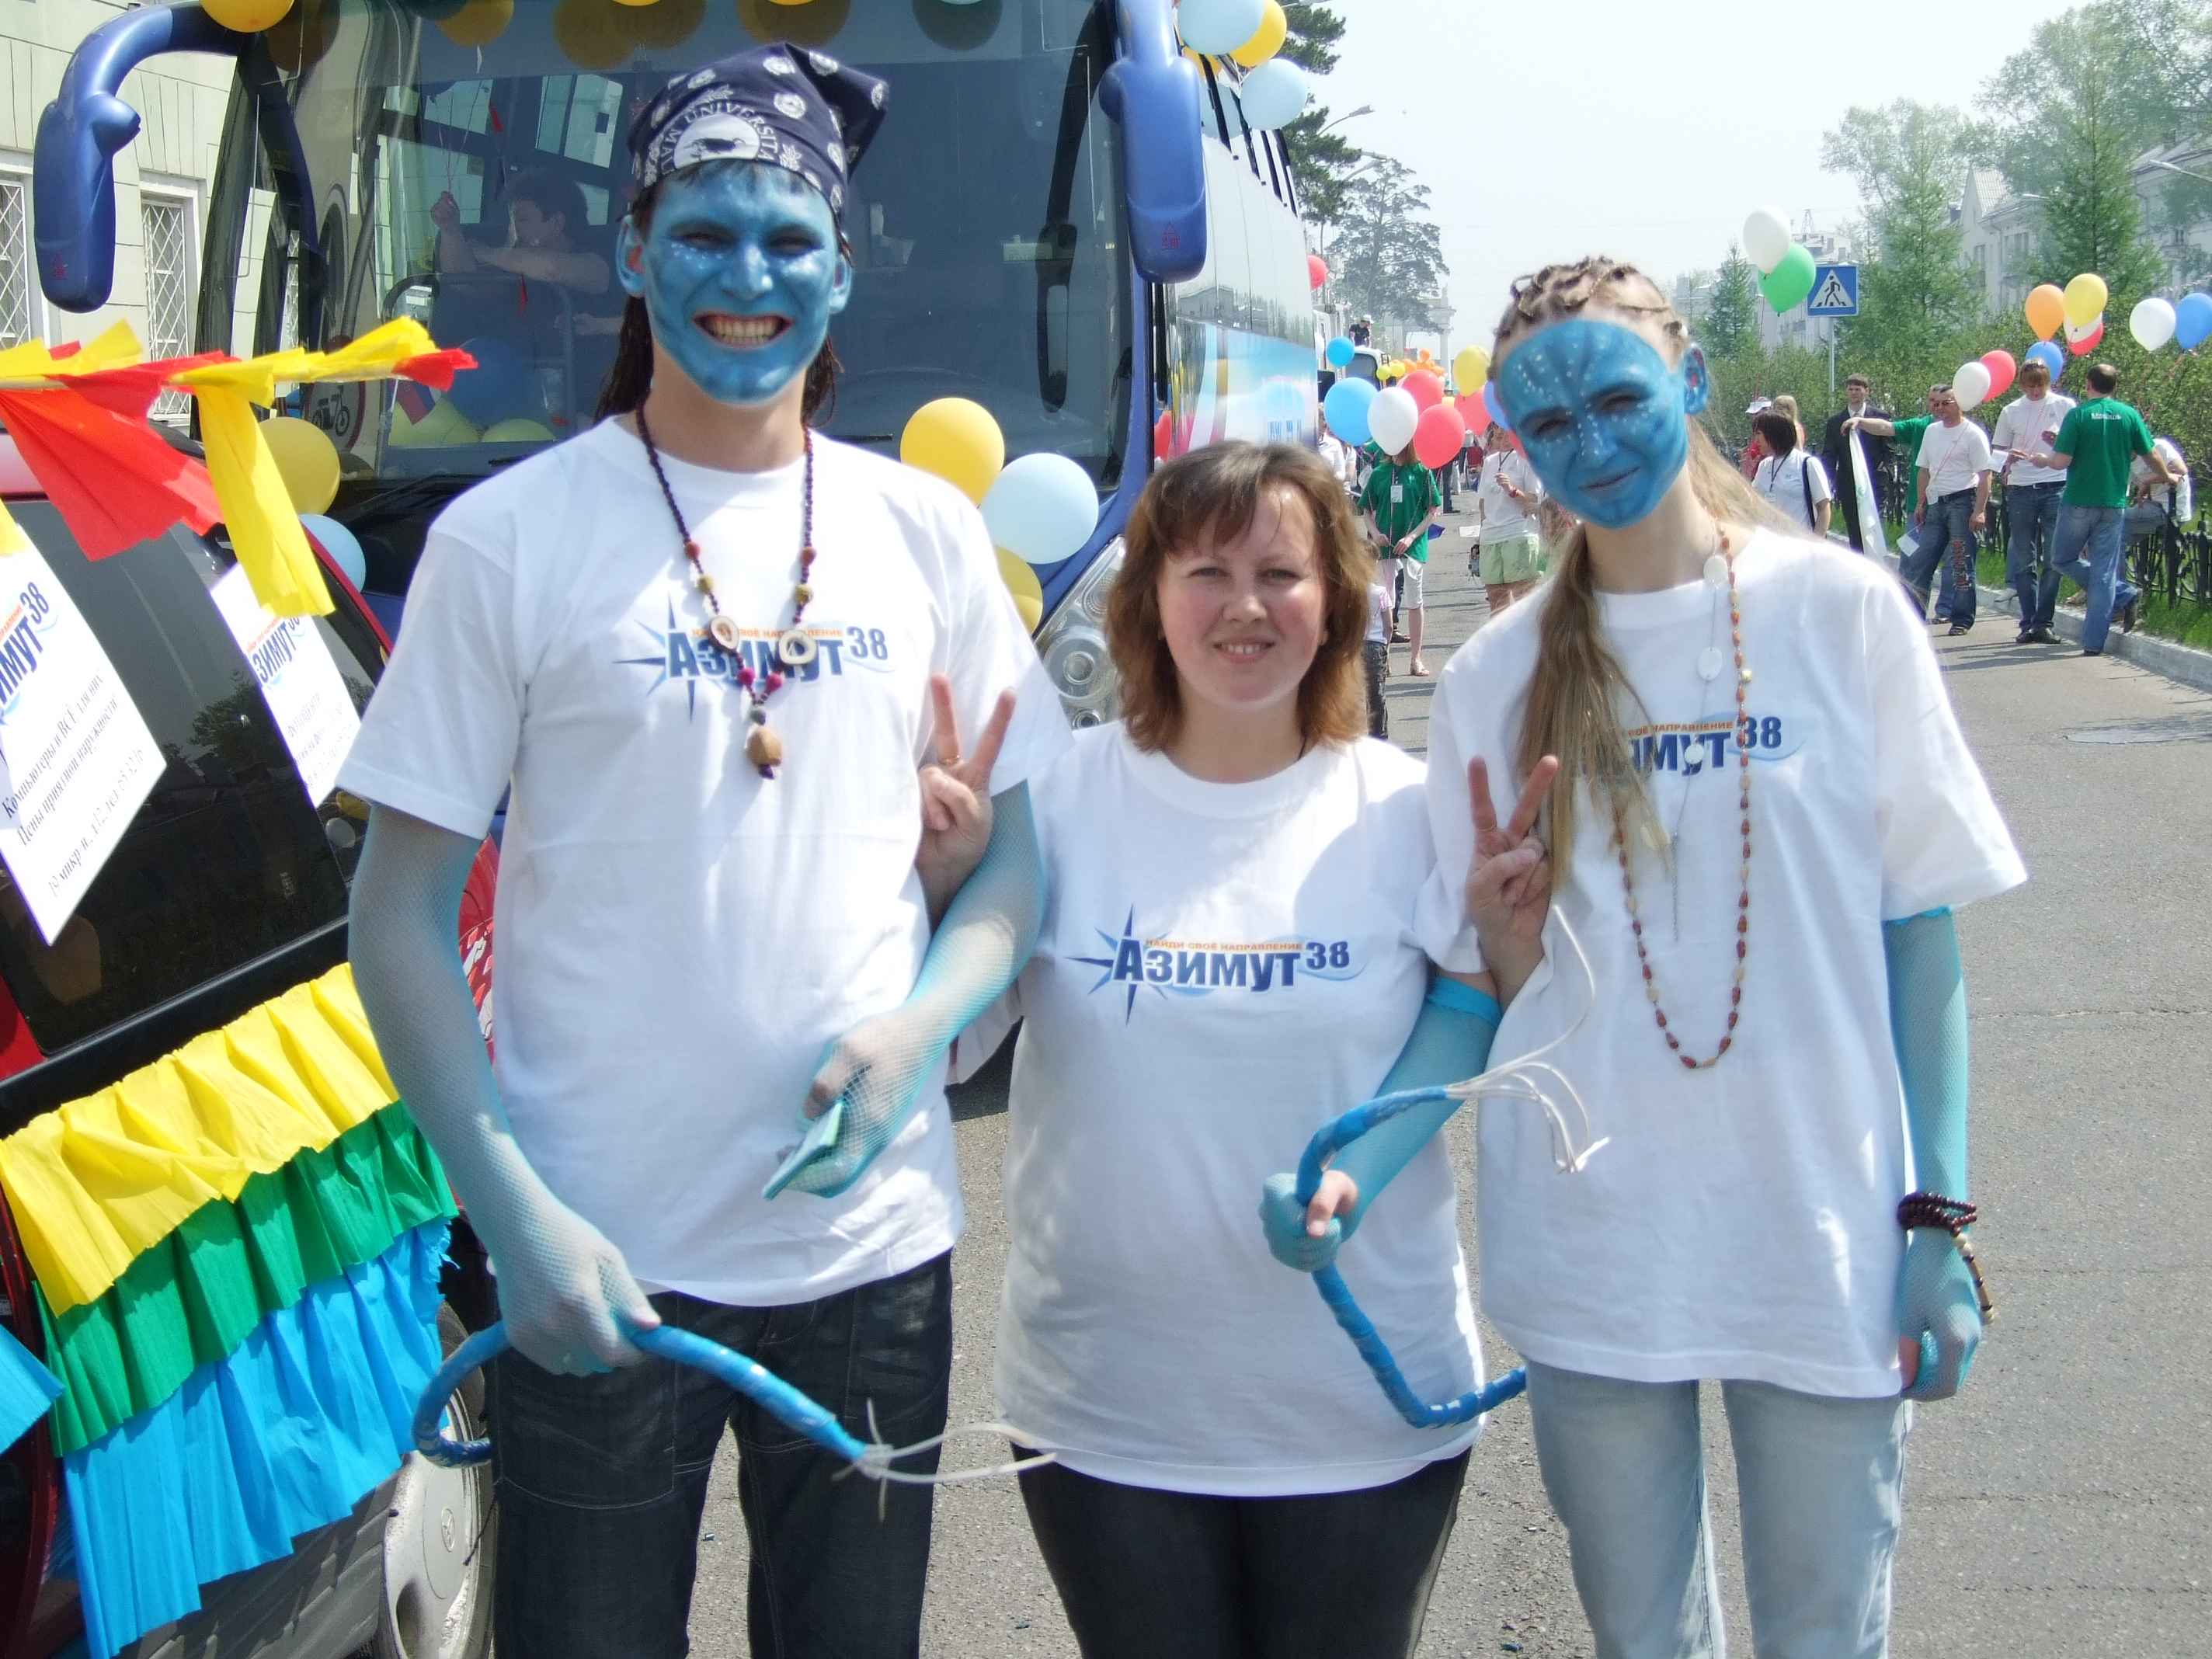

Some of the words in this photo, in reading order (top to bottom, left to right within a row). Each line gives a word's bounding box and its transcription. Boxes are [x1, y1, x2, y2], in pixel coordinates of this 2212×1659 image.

[20, 582, 49, 624] 38
[847, 626, 889, 660] 38
[1146, 939, 1184, 949] НАЙДИ
[1220, 942, 1303, 951] НАПРАВЛЕНИЕ
[1306, 941, 1350, 970] 38
